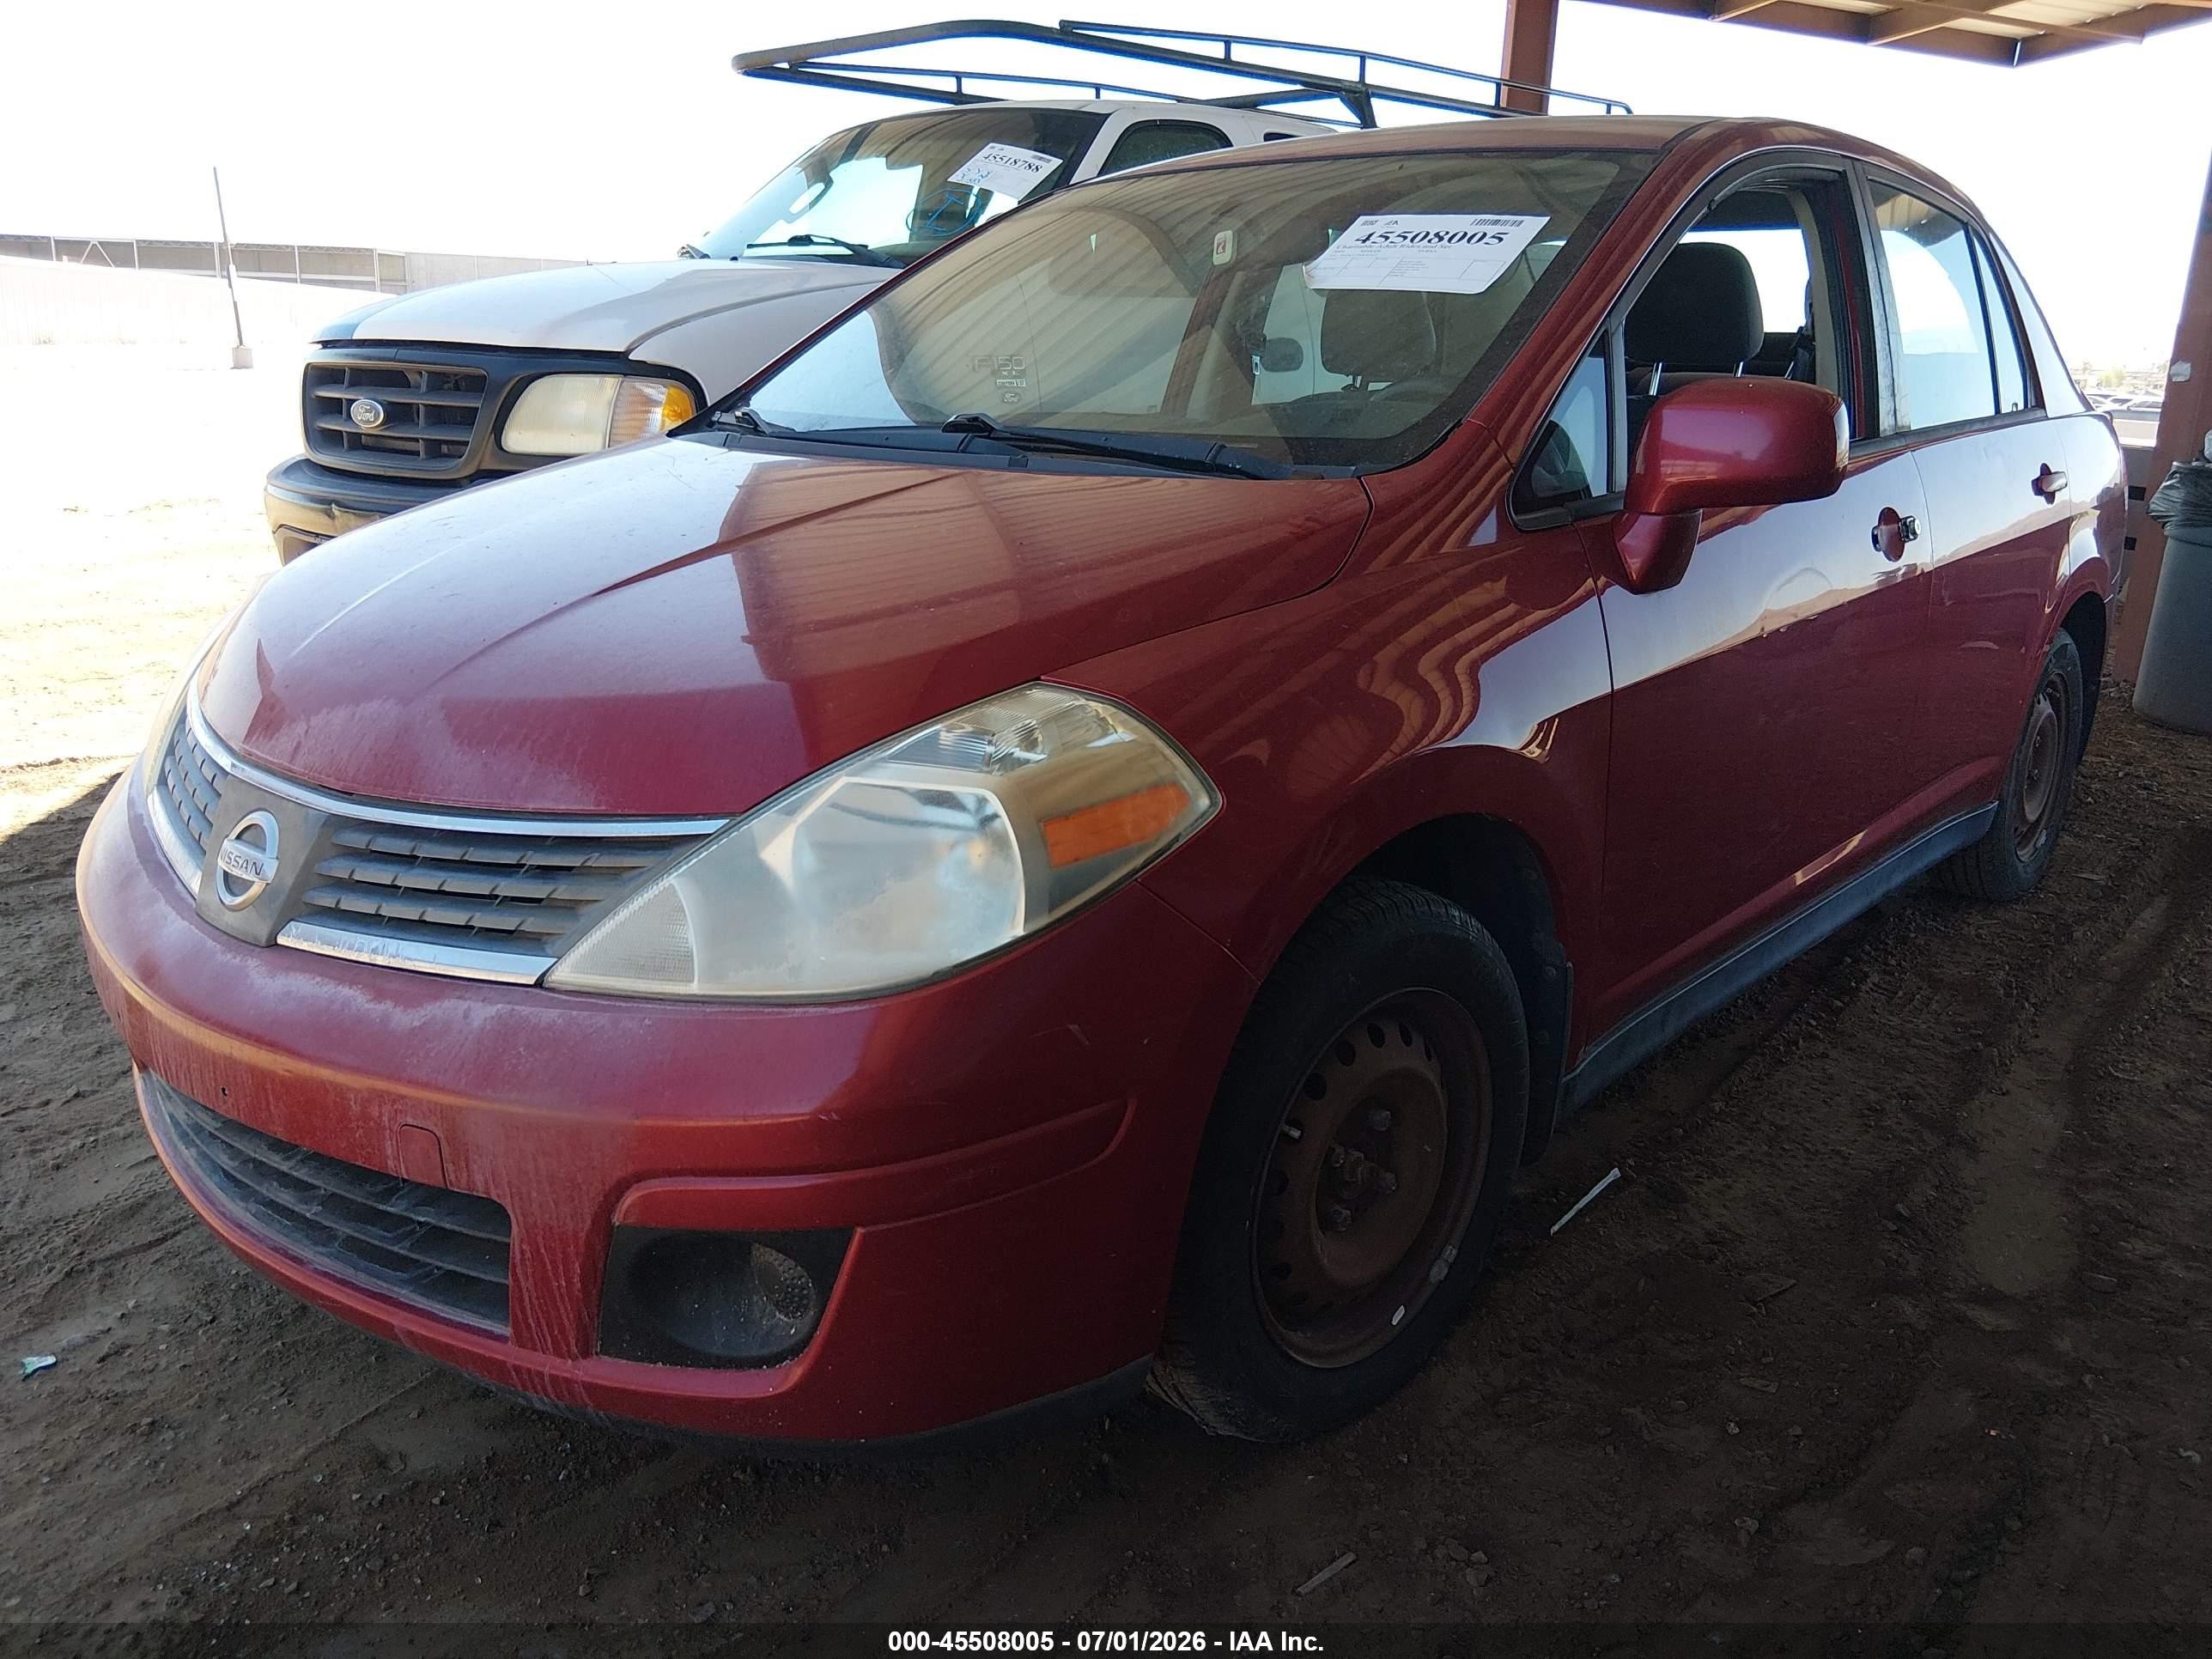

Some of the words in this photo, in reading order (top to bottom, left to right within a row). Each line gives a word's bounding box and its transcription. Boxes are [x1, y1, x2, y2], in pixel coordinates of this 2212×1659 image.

[983, 152, 1043, 173] 45518788
[1354, 230, 1510, 245] 45508005
[357, 404, 375, 422] Ford
